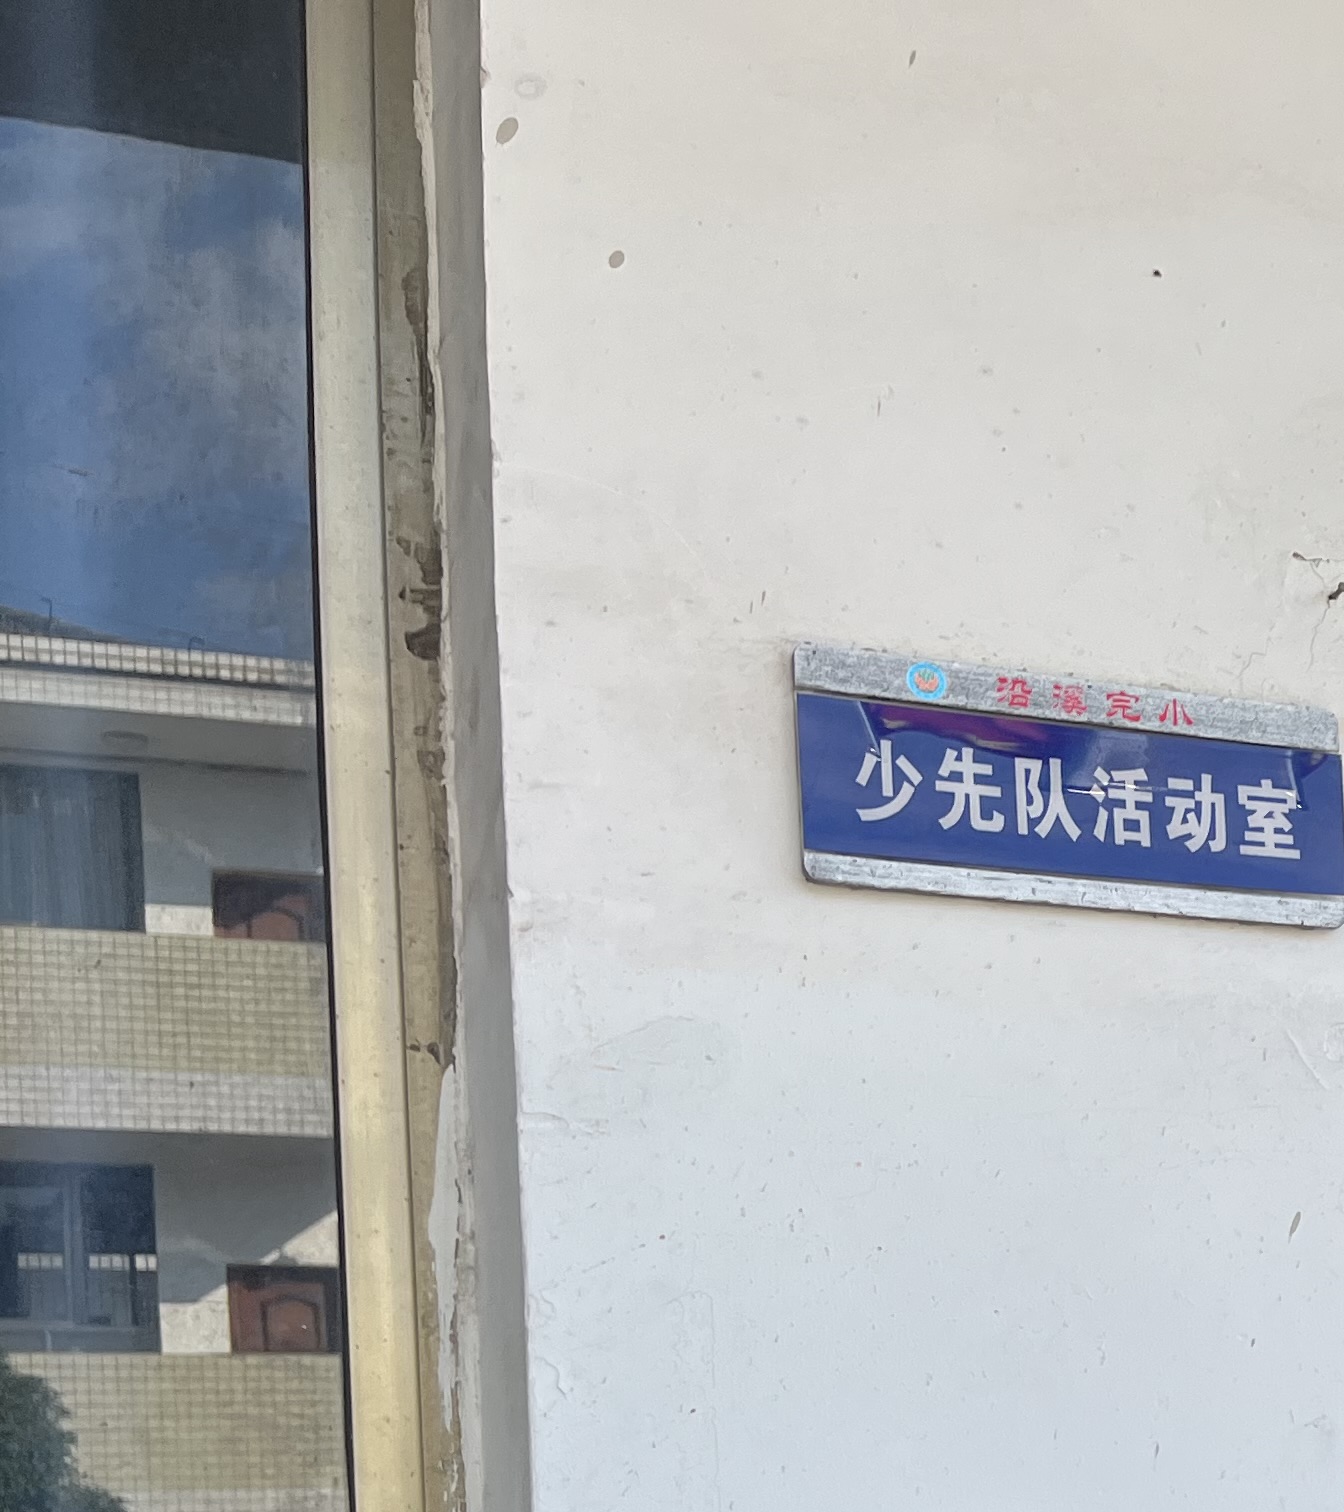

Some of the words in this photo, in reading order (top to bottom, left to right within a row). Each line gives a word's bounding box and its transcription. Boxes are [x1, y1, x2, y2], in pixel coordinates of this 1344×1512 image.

[994, 674, 1194, 727] 沿溪完小
[854, 739, 1302, 860] 少先队活动室
